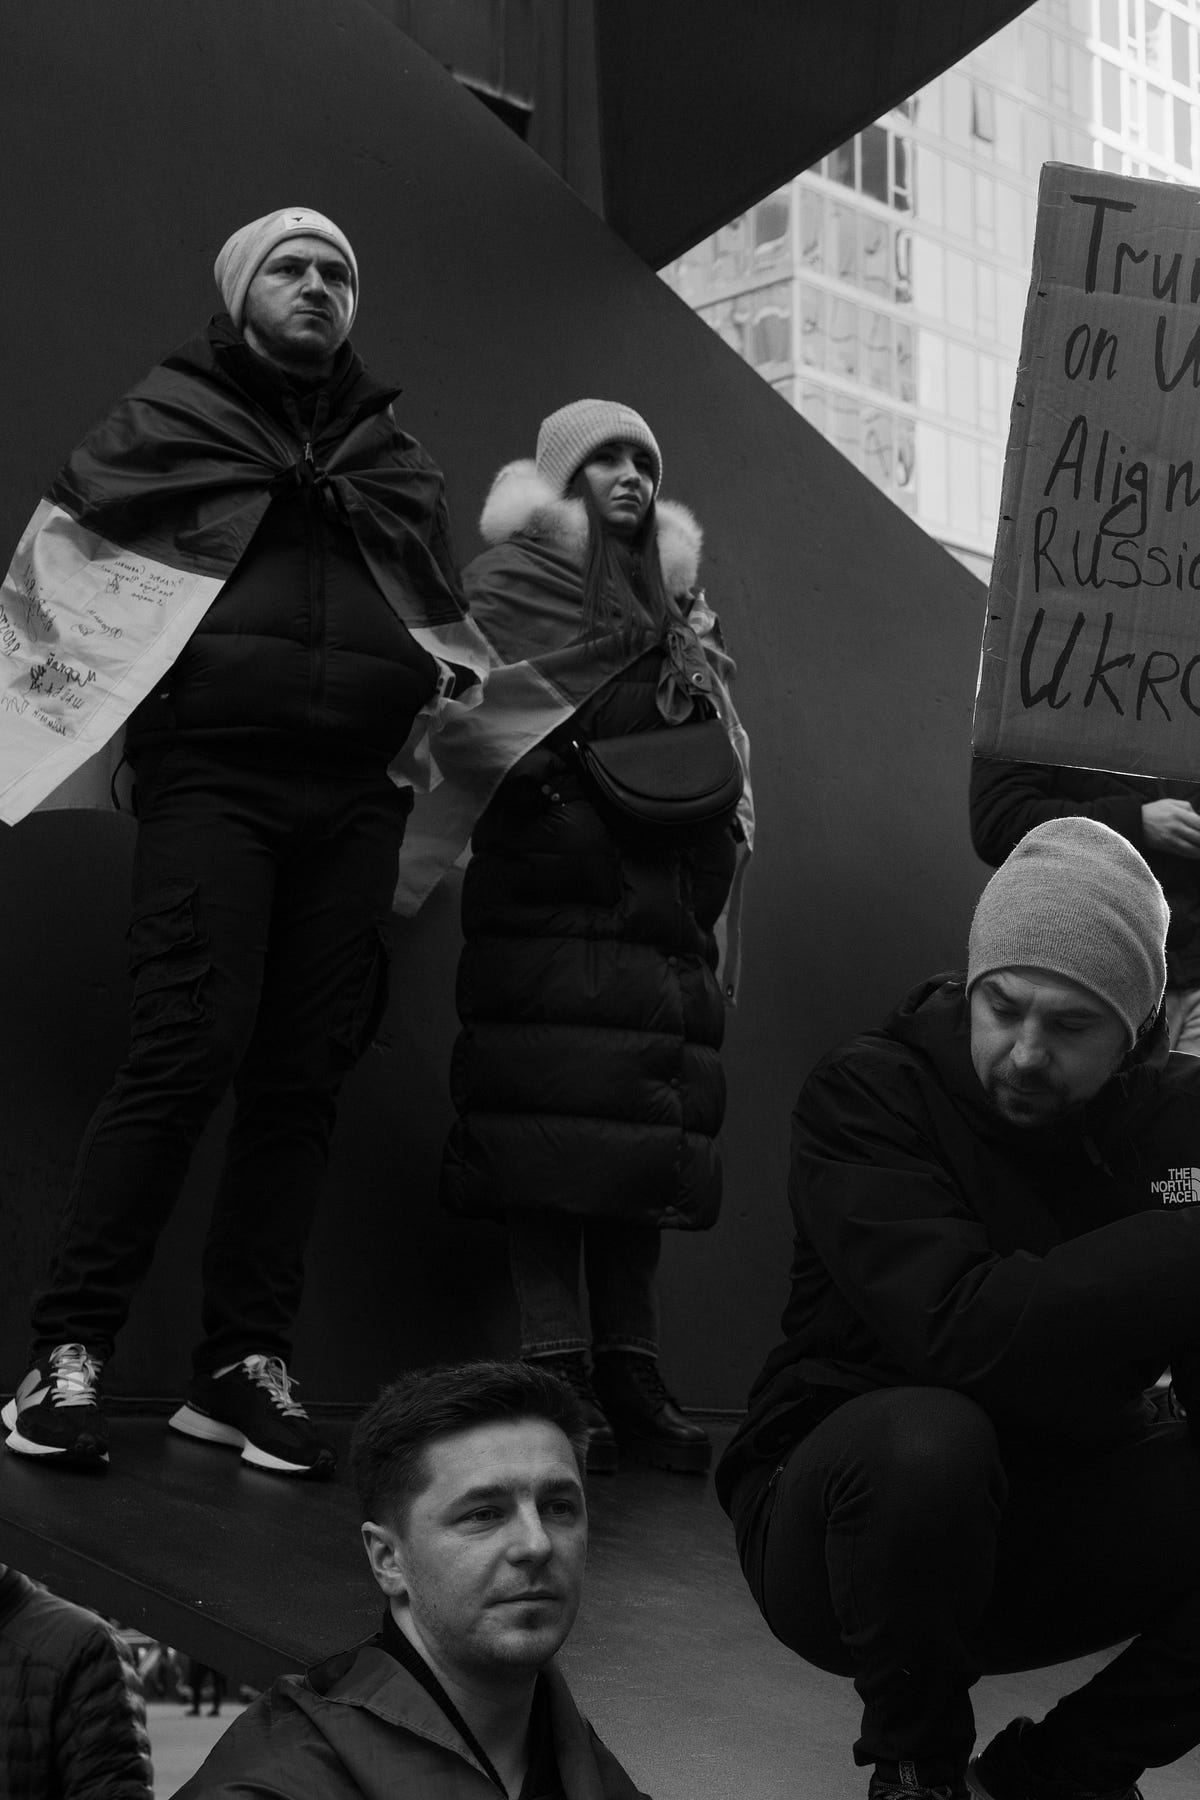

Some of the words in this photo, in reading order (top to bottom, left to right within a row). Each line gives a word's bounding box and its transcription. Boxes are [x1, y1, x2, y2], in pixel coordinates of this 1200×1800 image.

[1064, 323, 1118, 381] on
[1168, 1167, 1190, 1180] THE
[1151, 1179, 1191, 1193] NORTH
[1163, 1191, 1192, 1204] FACE
